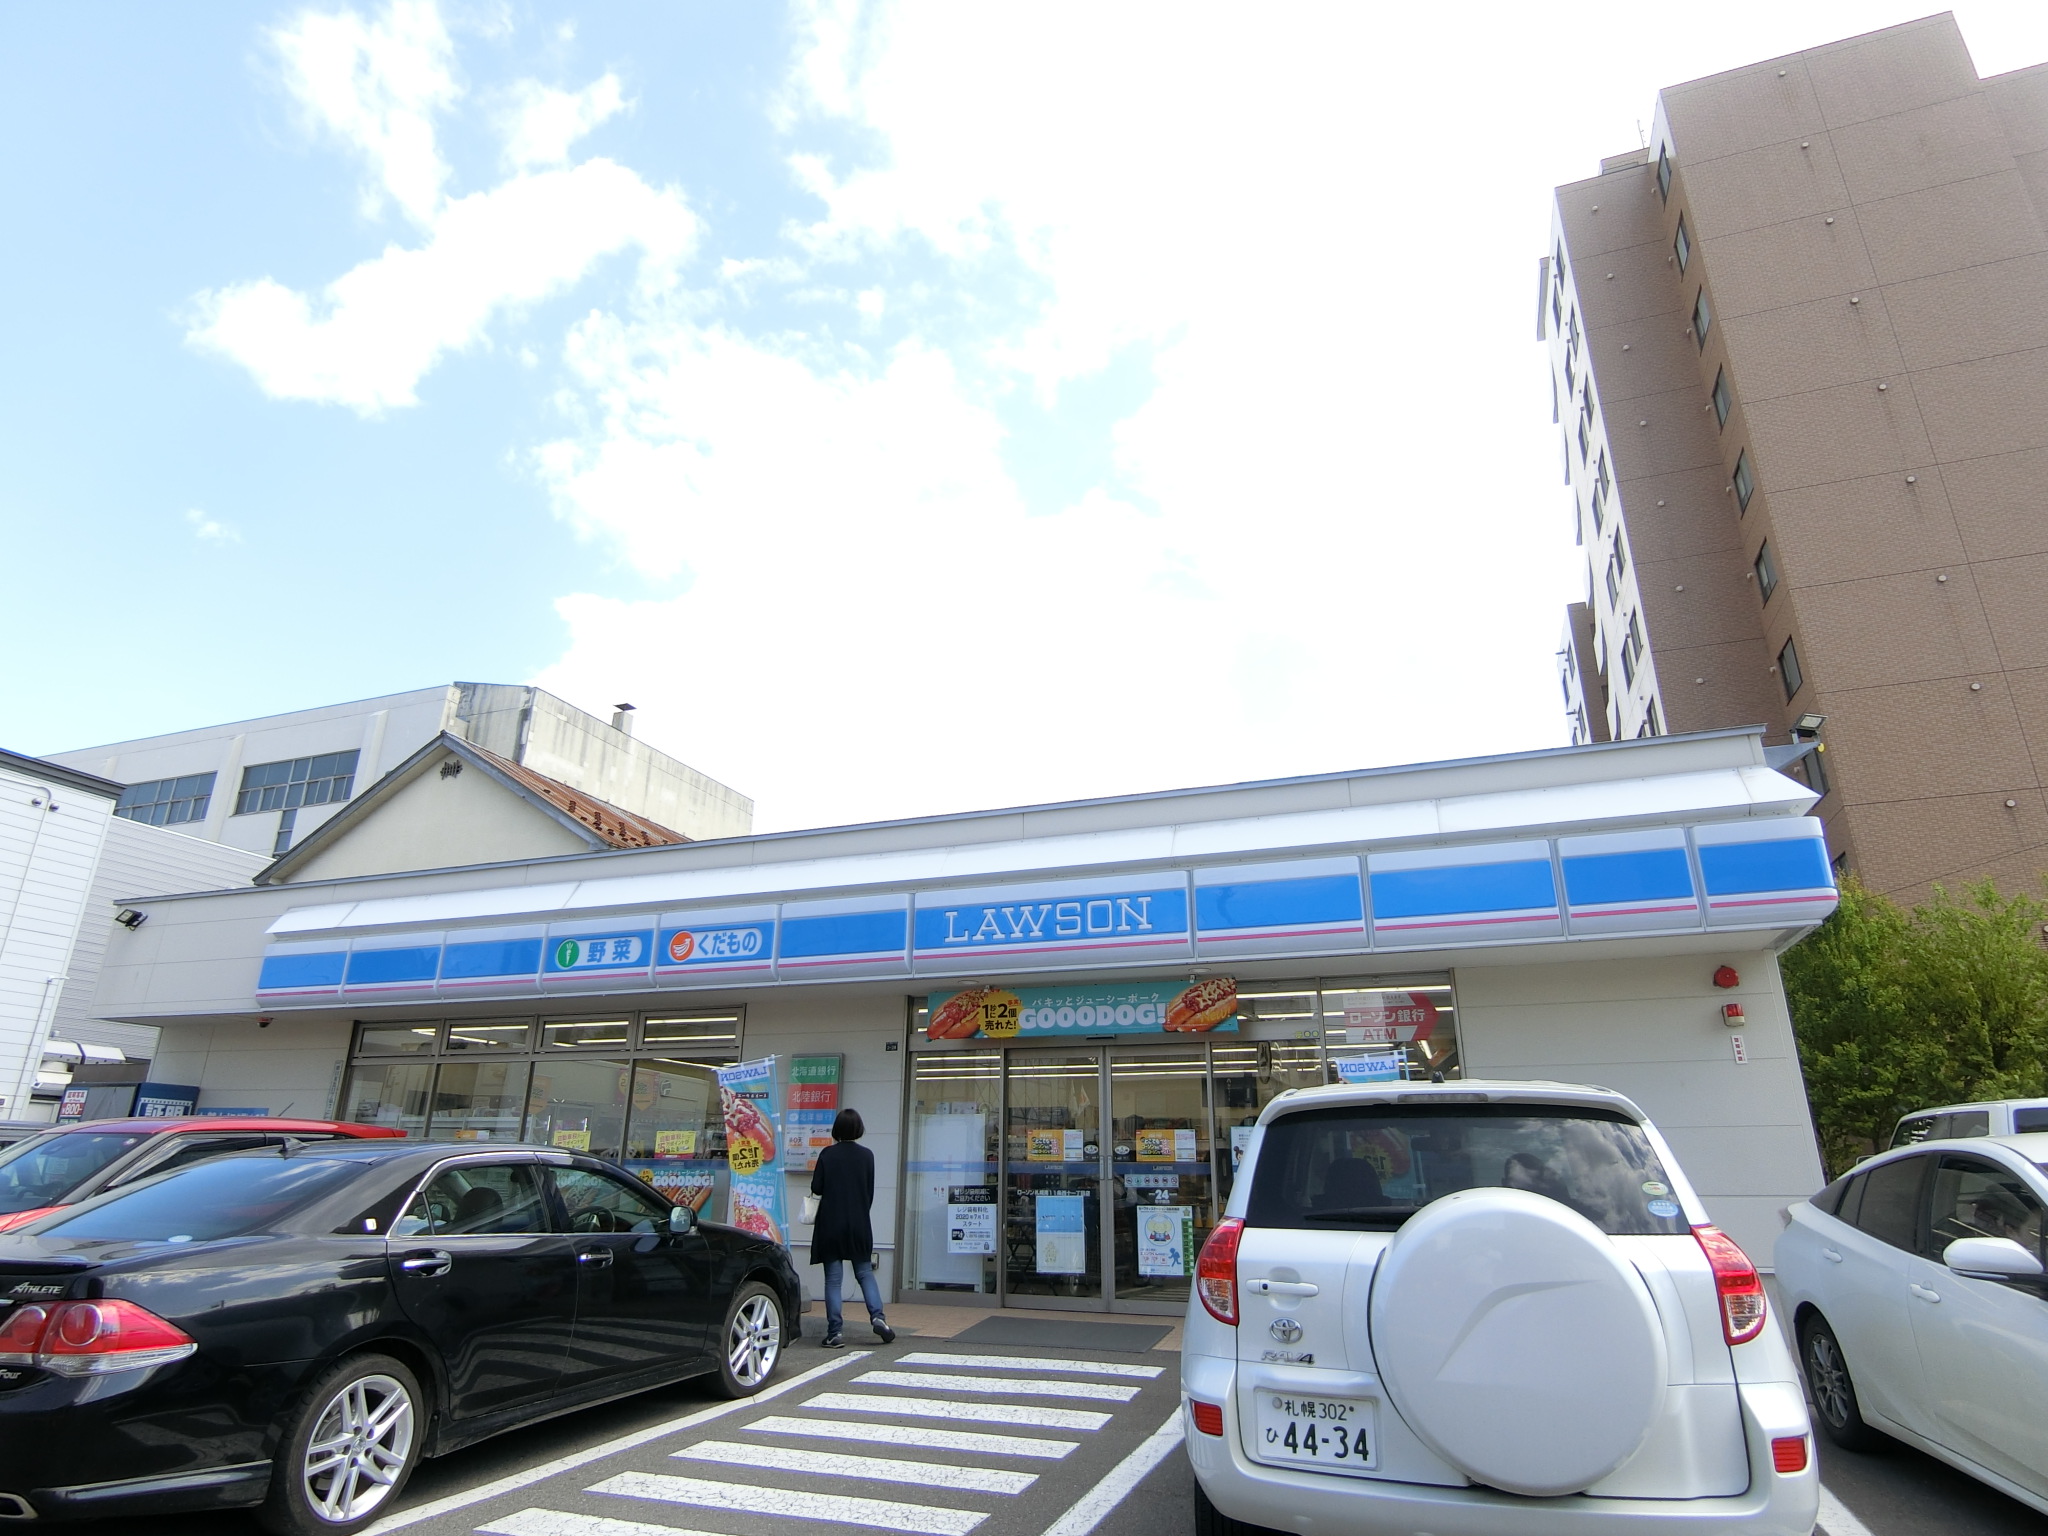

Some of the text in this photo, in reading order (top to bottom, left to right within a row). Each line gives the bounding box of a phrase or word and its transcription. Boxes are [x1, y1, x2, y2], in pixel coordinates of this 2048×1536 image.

[944, 896, 1153, 944] LAWSON
[586, 937, 633, 962] 野菜
[697, 929, 758, 956] くだもの
[1018, 1002, 1167, 1029] GOOODOG!
[1349, 1008, 1426, 1024] ローソン銀行
[984, 1019, 1017, 1030] 売れた!
[1362, 1027, 1397, 1041] ATM
[791, 1065, 836, 1077] 北海道銀行
[792, 1090, 831, 1103] 北陸銀行
[653, 1175, 715, 1187] GOOODOG!
[1155, 1189, 1169, 1200] 24
[1261, 1350, 1315, 1365] RAV4
[1265, 1421, 1370, 1462] ひ 44-34
